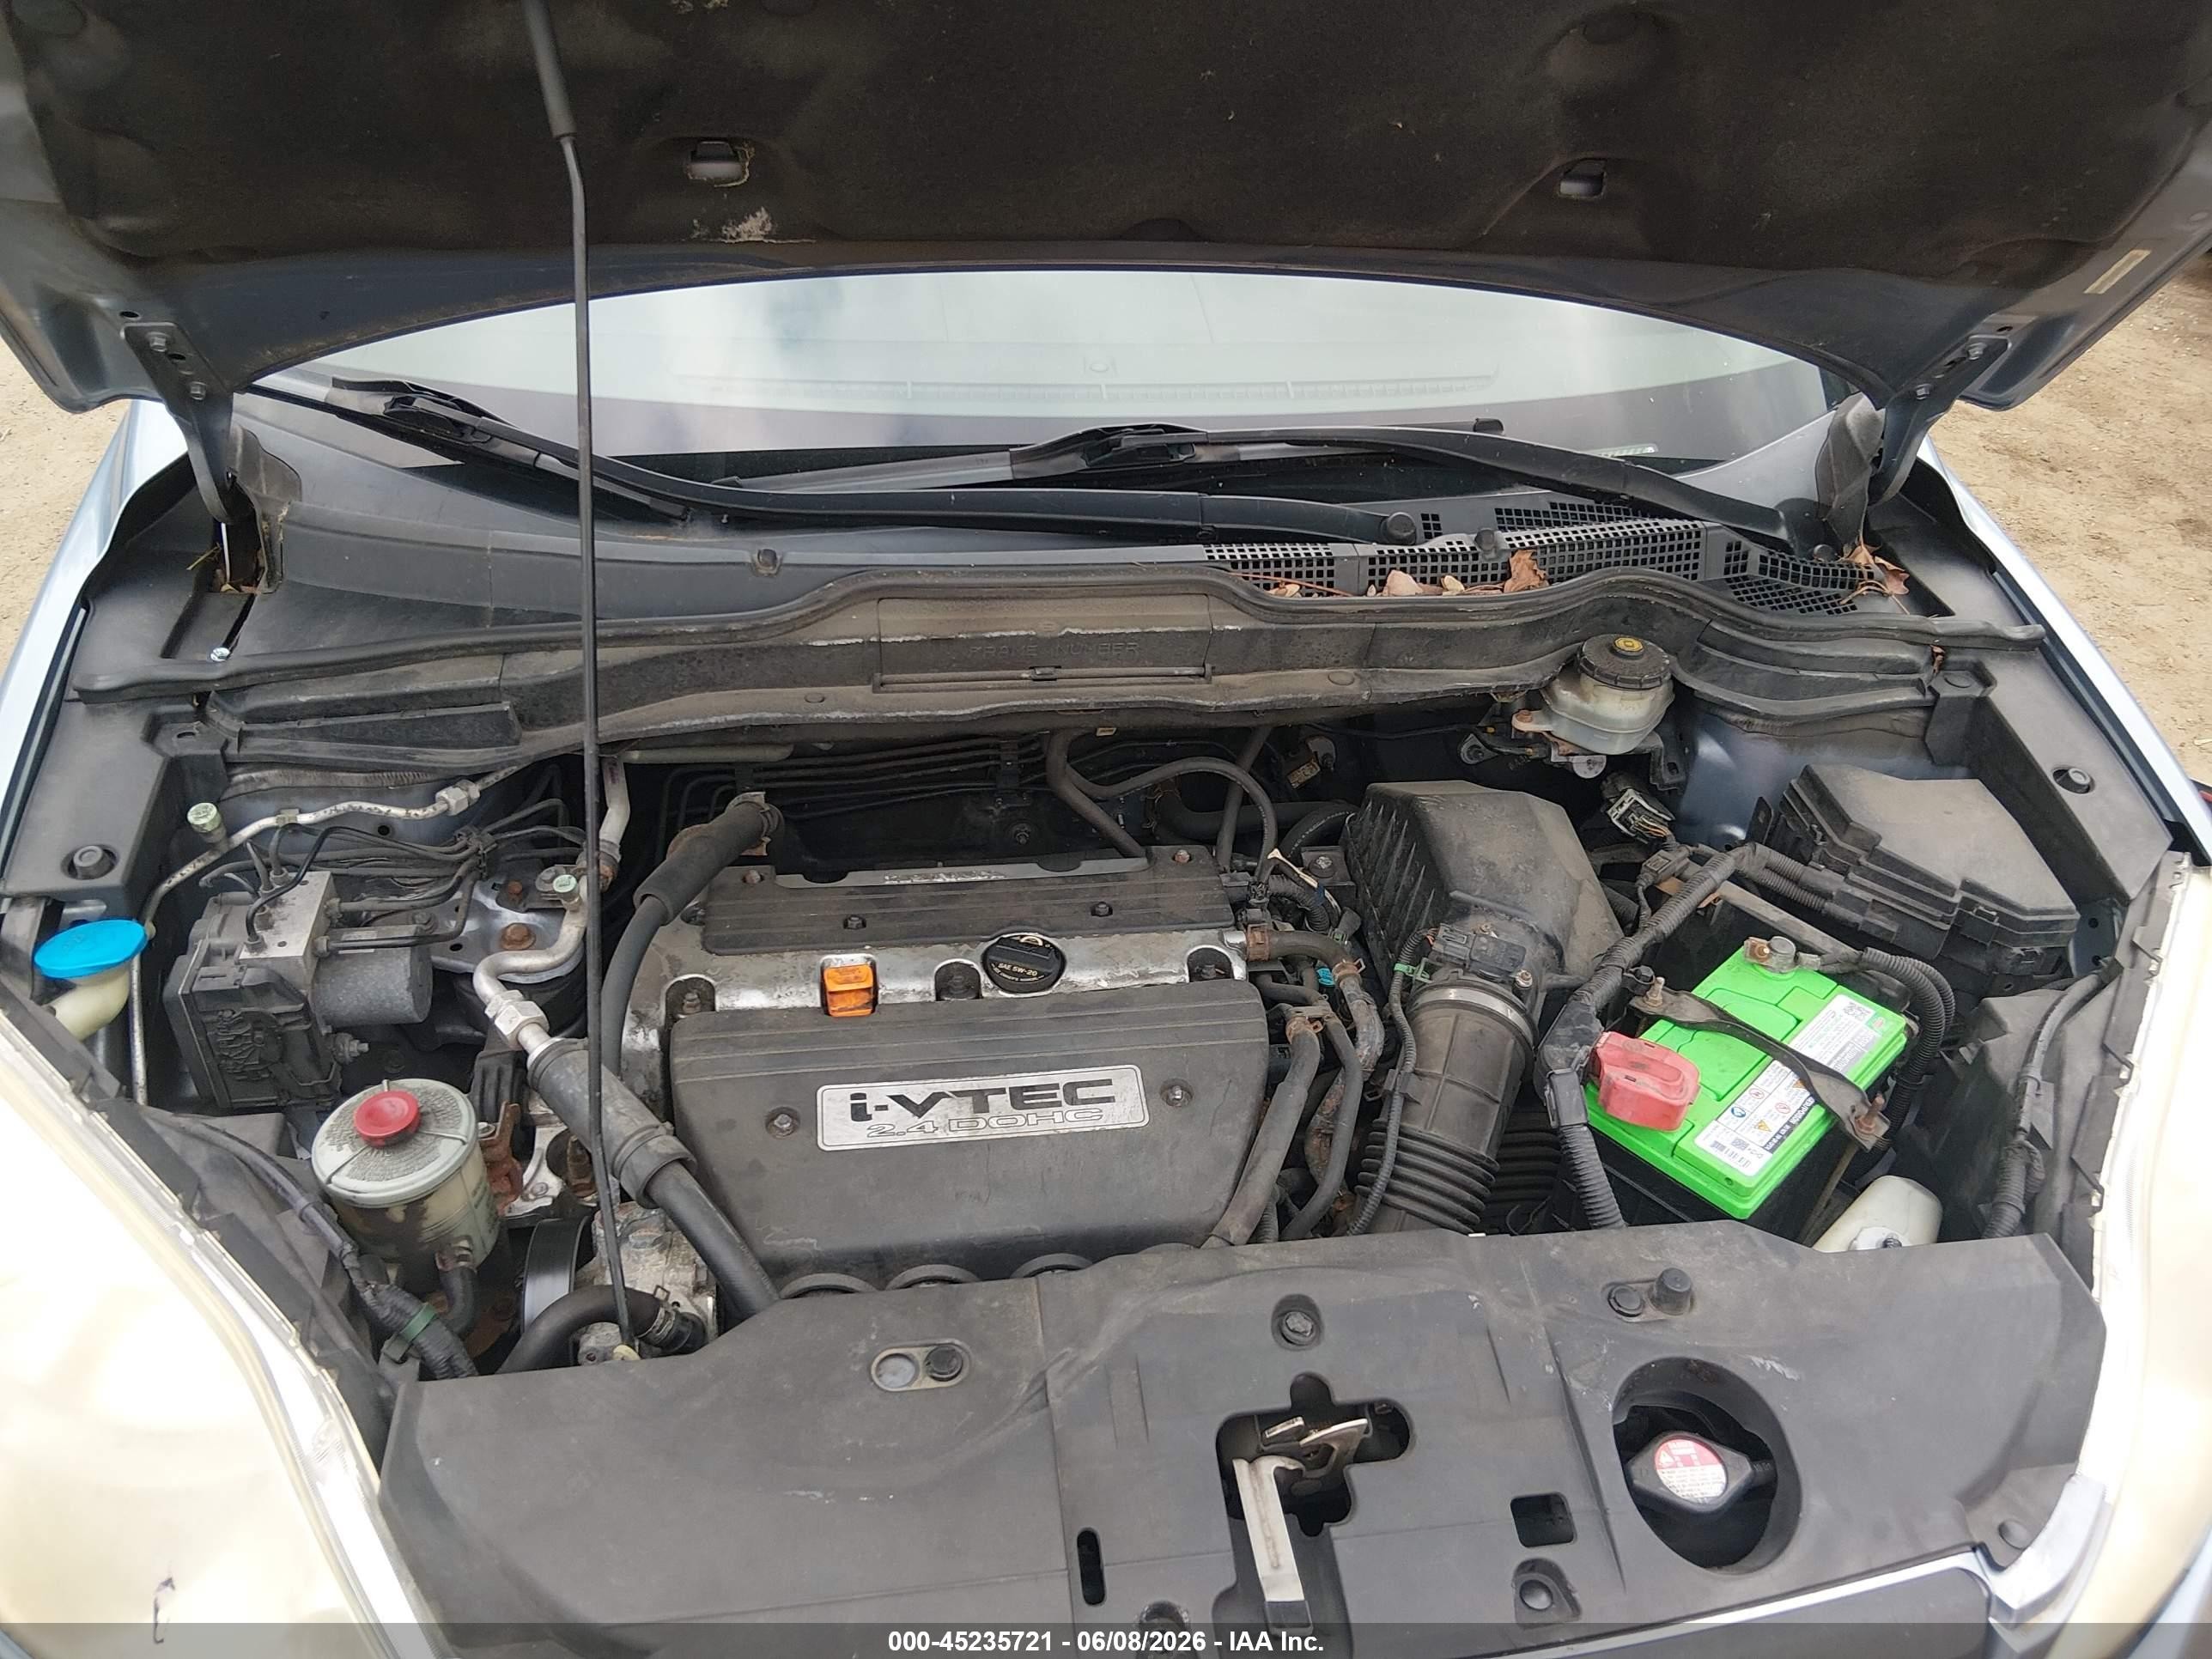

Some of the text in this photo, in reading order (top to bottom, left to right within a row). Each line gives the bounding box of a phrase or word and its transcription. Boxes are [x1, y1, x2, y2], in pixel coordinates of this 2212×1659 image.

[1012, 965, 1038, 976] 5W-20
[849, 1078, 1115, 1122] i-VTEC
[866, 1108, 1104, 1138] 2.4 DOHC
